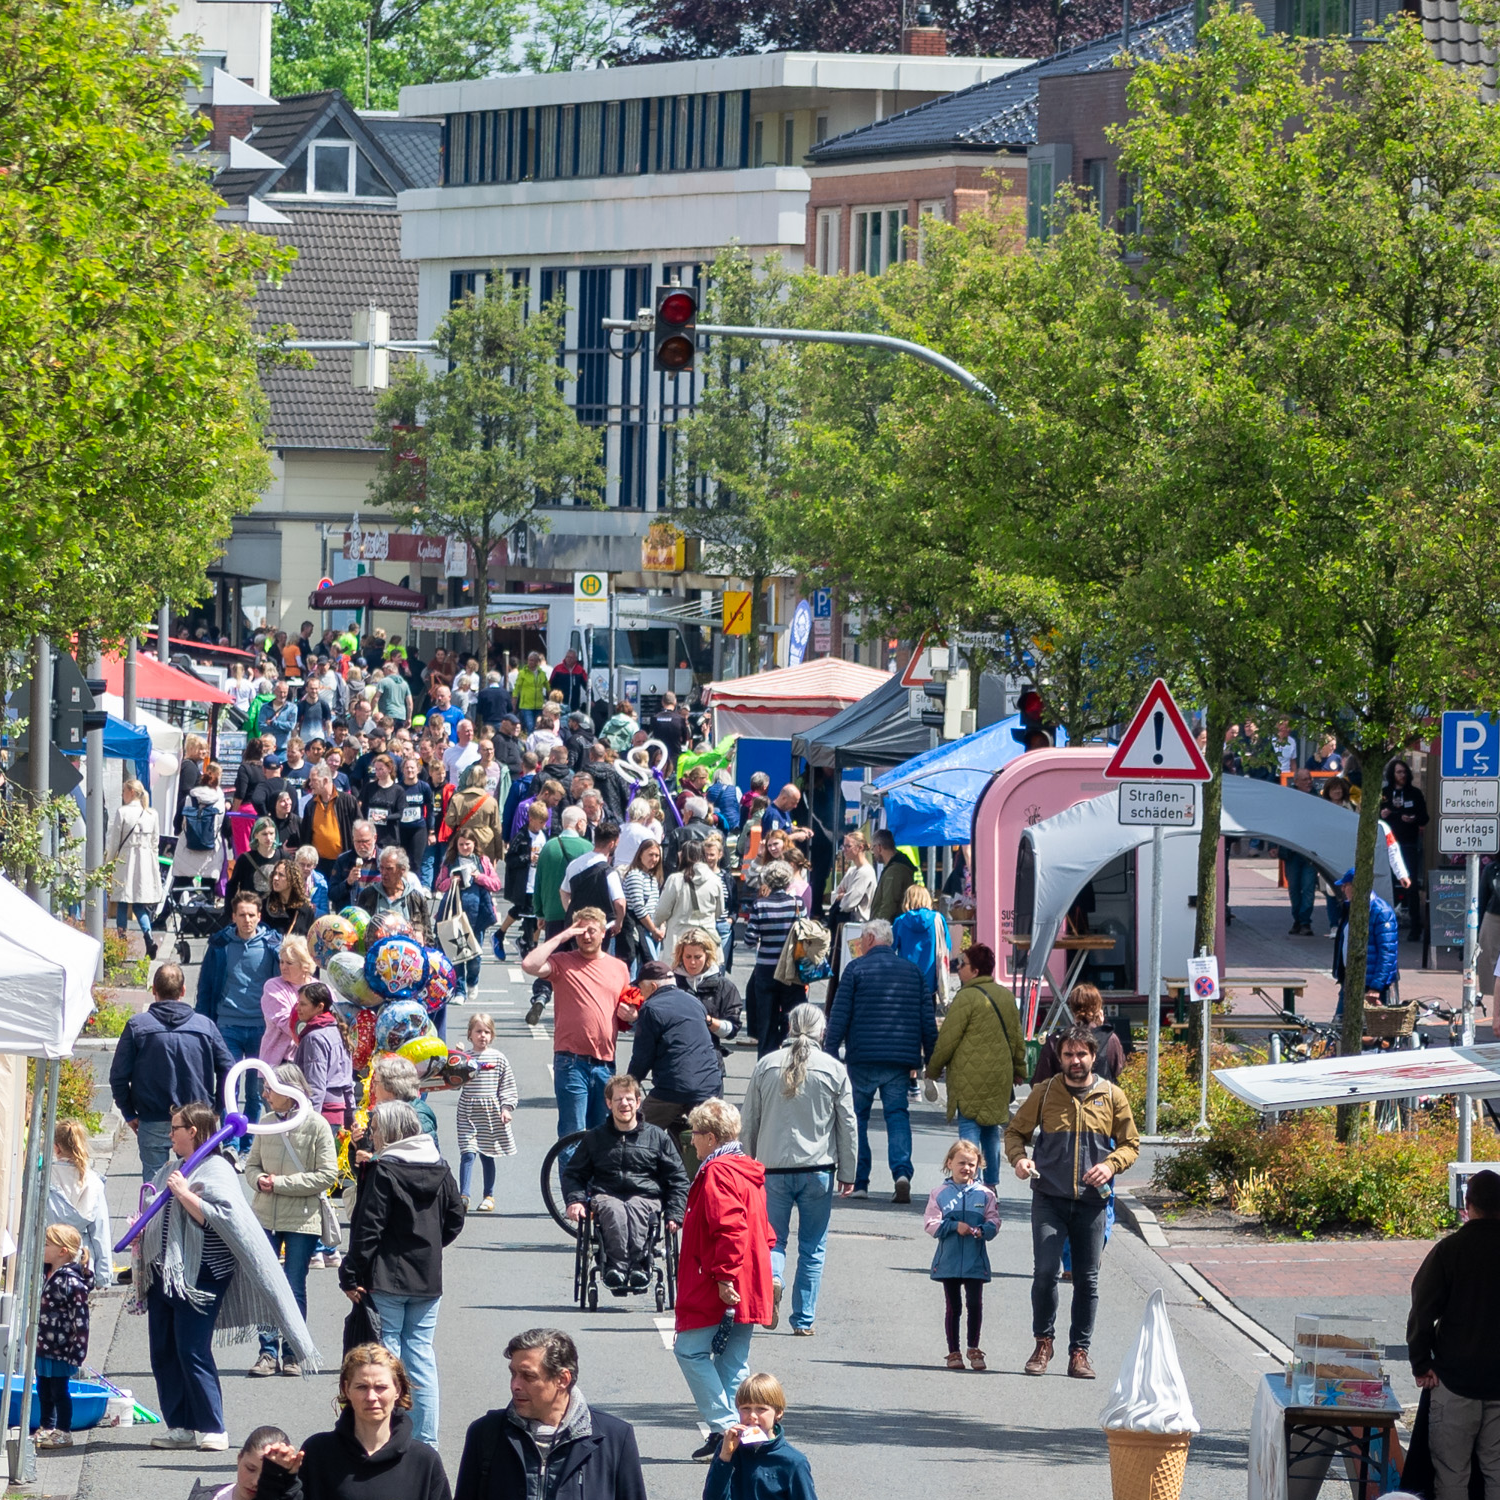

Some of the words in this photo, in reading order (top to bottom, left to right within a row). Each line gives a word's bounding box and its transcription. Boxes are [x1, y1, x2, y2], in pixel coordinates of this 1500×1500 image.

[818, 591, 828, 610] P
[502, 612, 539, 623] Smoothies
[1455, 720, 1487, 769] P
[1129, 789, 1185, 802] Straßen-
[1463, 788, 1477, 797] mit
[1445, 798, 1494, 808] Parkschein
[1130, 806, 1183, 819] schäden
[1445, 824, 1494, 836] werktags
[1455, 837, 1482, 847] 8-19h
